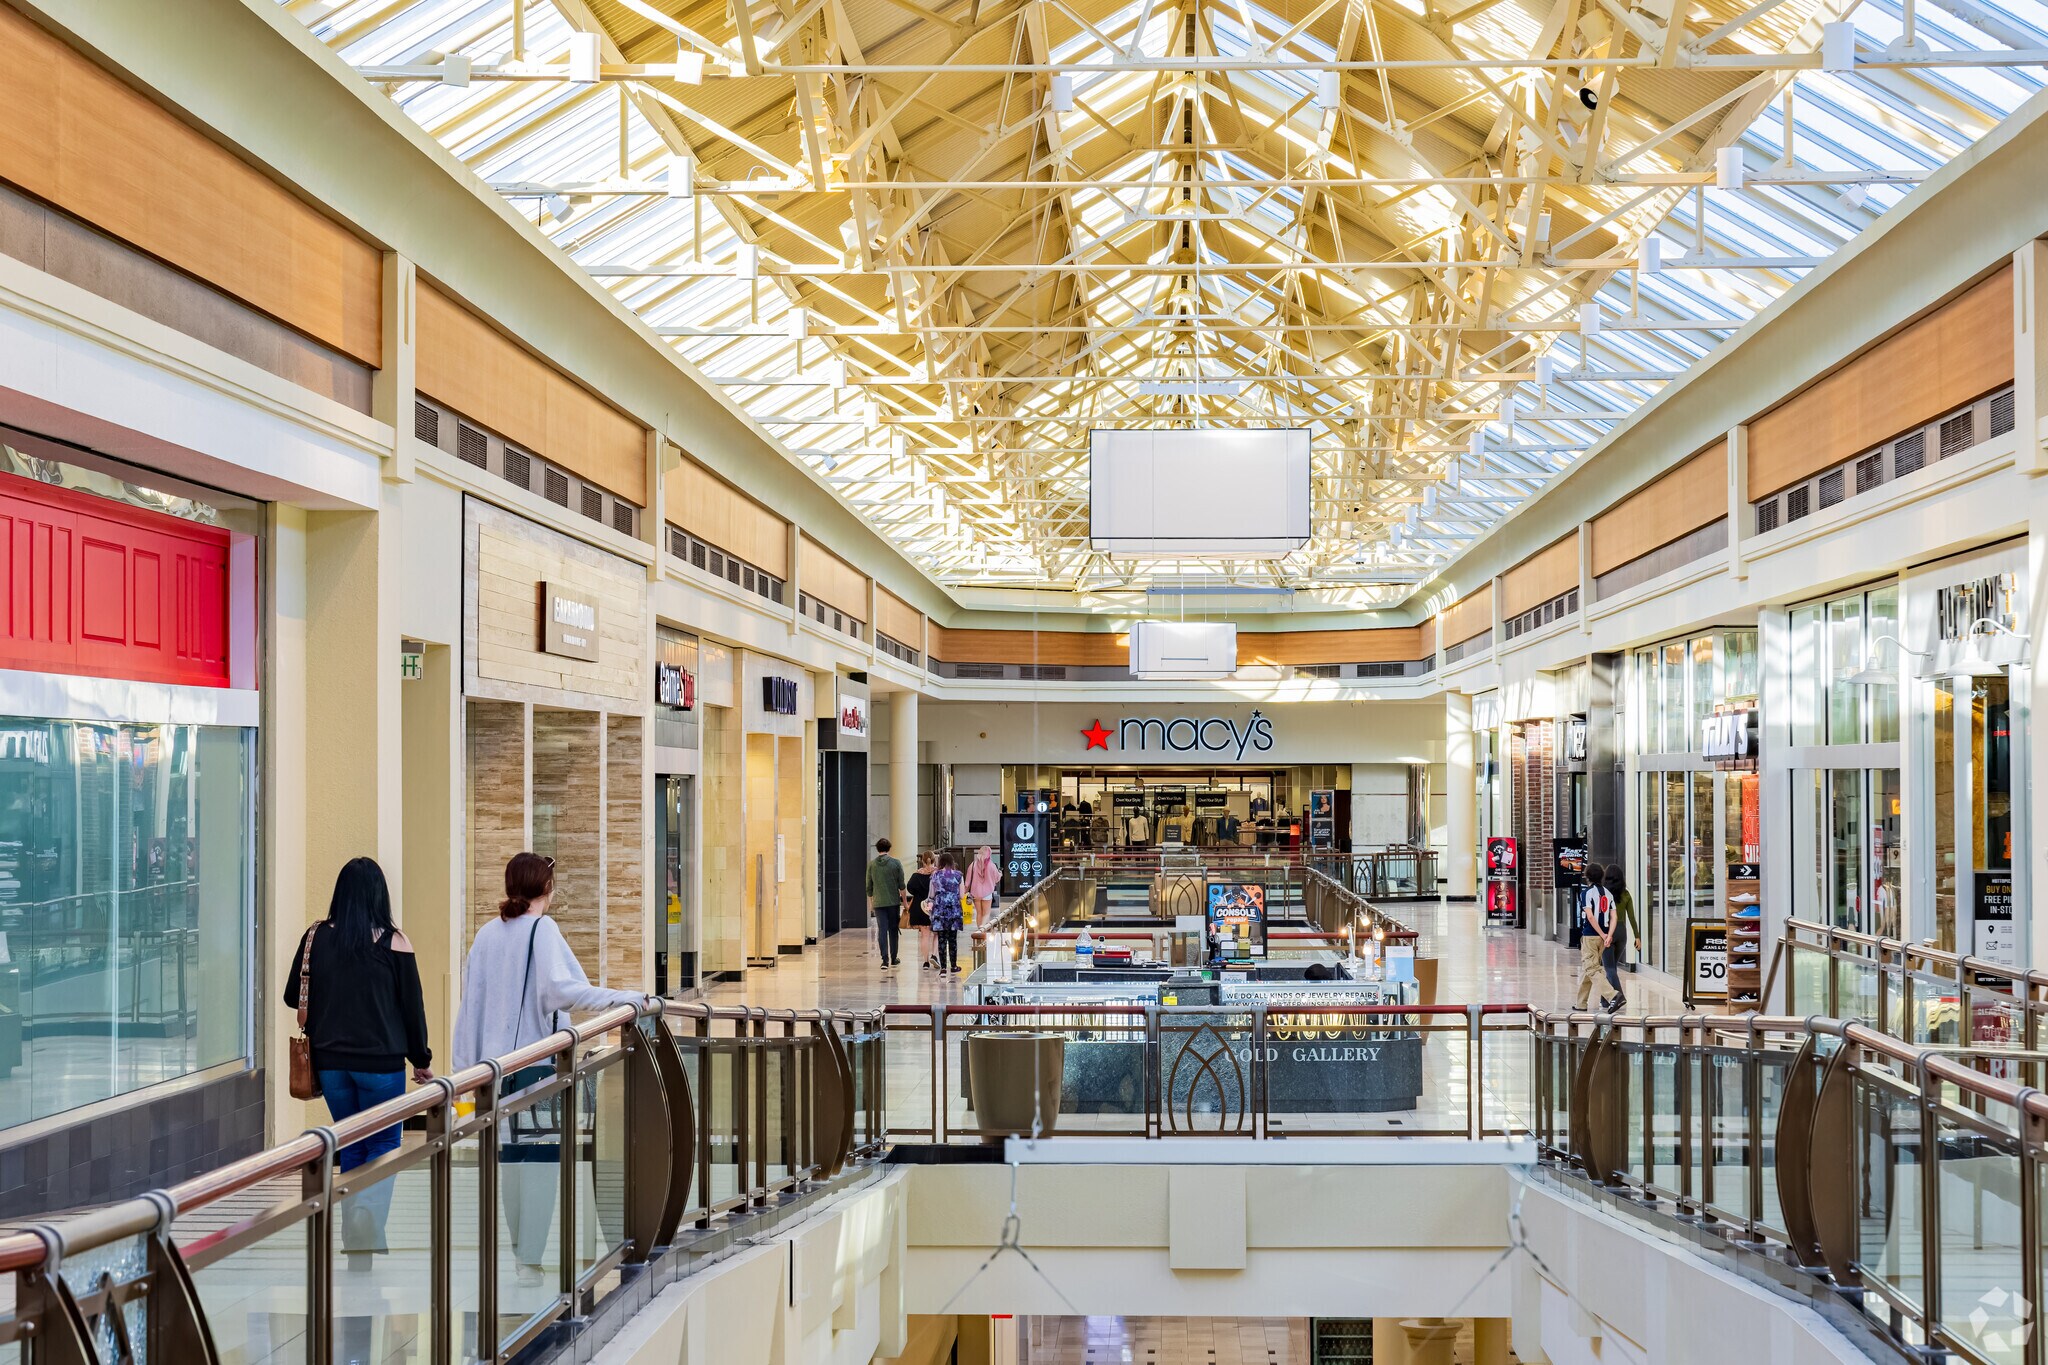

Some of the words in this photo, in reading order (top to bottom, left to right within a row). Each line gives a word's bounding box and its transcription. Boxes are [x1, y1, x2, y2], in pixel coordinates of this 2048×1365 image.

[1986, 885, 2001, 894] BUY
[1984, 895, 2002, 904] FREE
[1216, 908, 1257, 918] CONSOLE
[1226, 916, 1247, 924] repair
[1699, 962, 1727, 979] 50
[1345, 991, 1377, 999] REPAIRS
[1292, 1047, 1381, 1062] GALLERY
